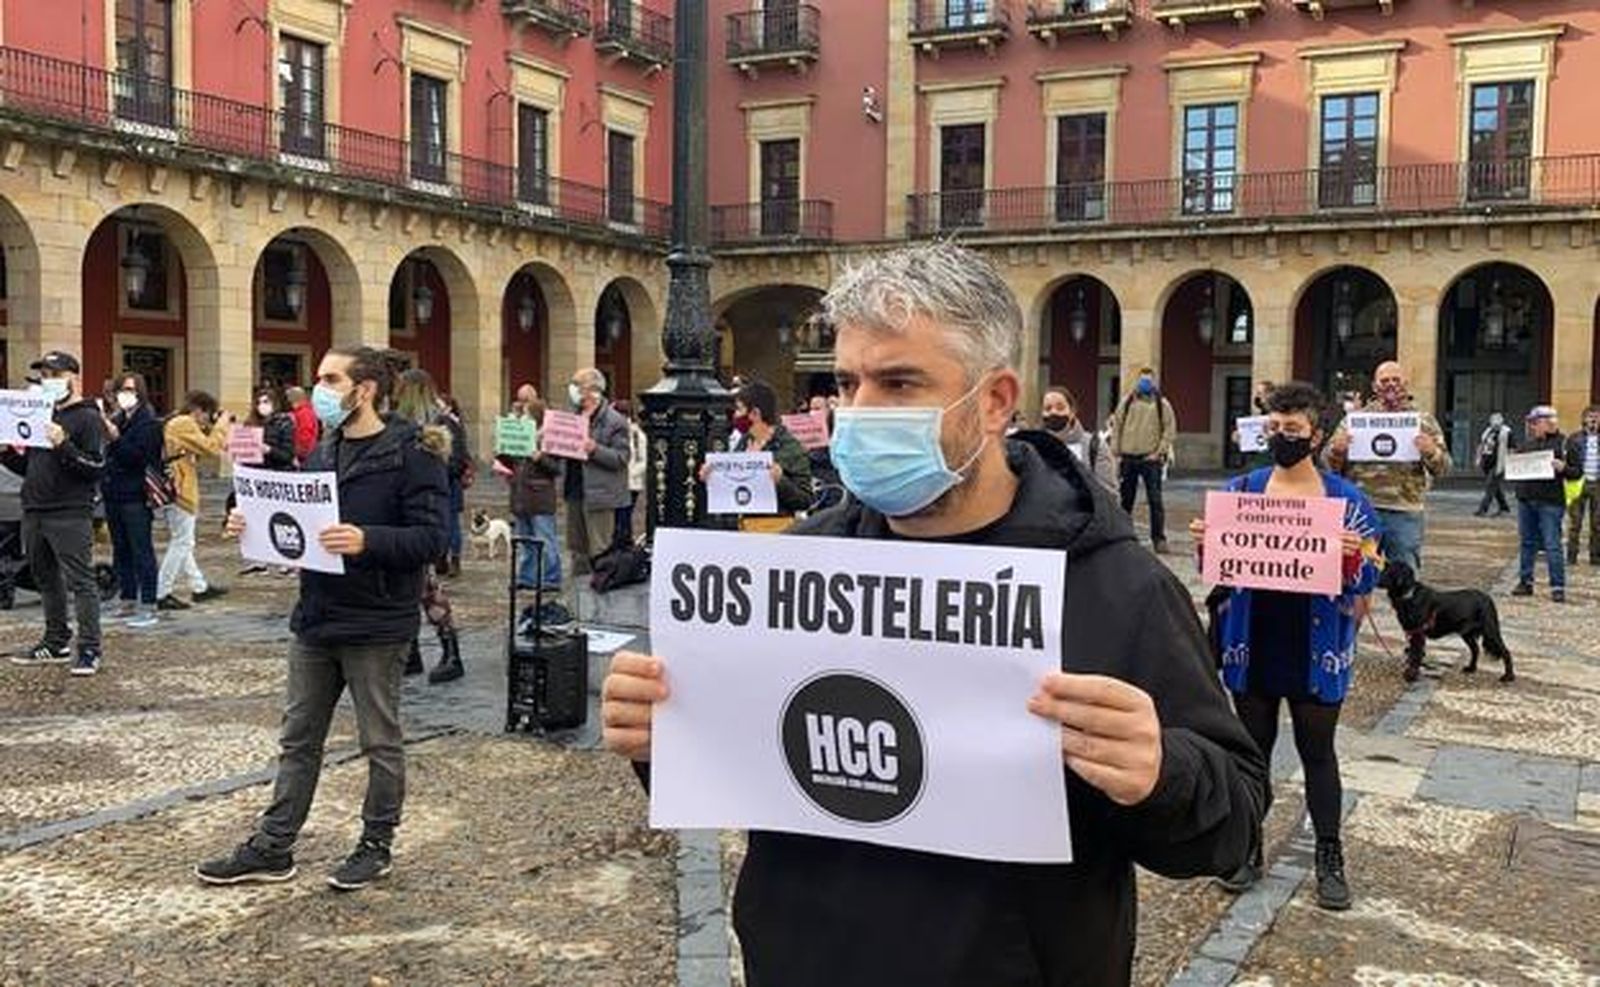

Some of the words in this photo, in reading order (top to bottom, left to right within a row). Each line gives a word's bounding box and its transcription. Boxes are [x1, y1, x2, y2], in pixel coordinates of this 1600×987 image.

[1220, 530, 1327, 553] corazón
[1220, 558, 1314, 581] grande
[671, 563, 751, 626] SOS
[768, 566, 1044, 650] HOSTELERÍA
[805, 712, 898, 781] HCC
